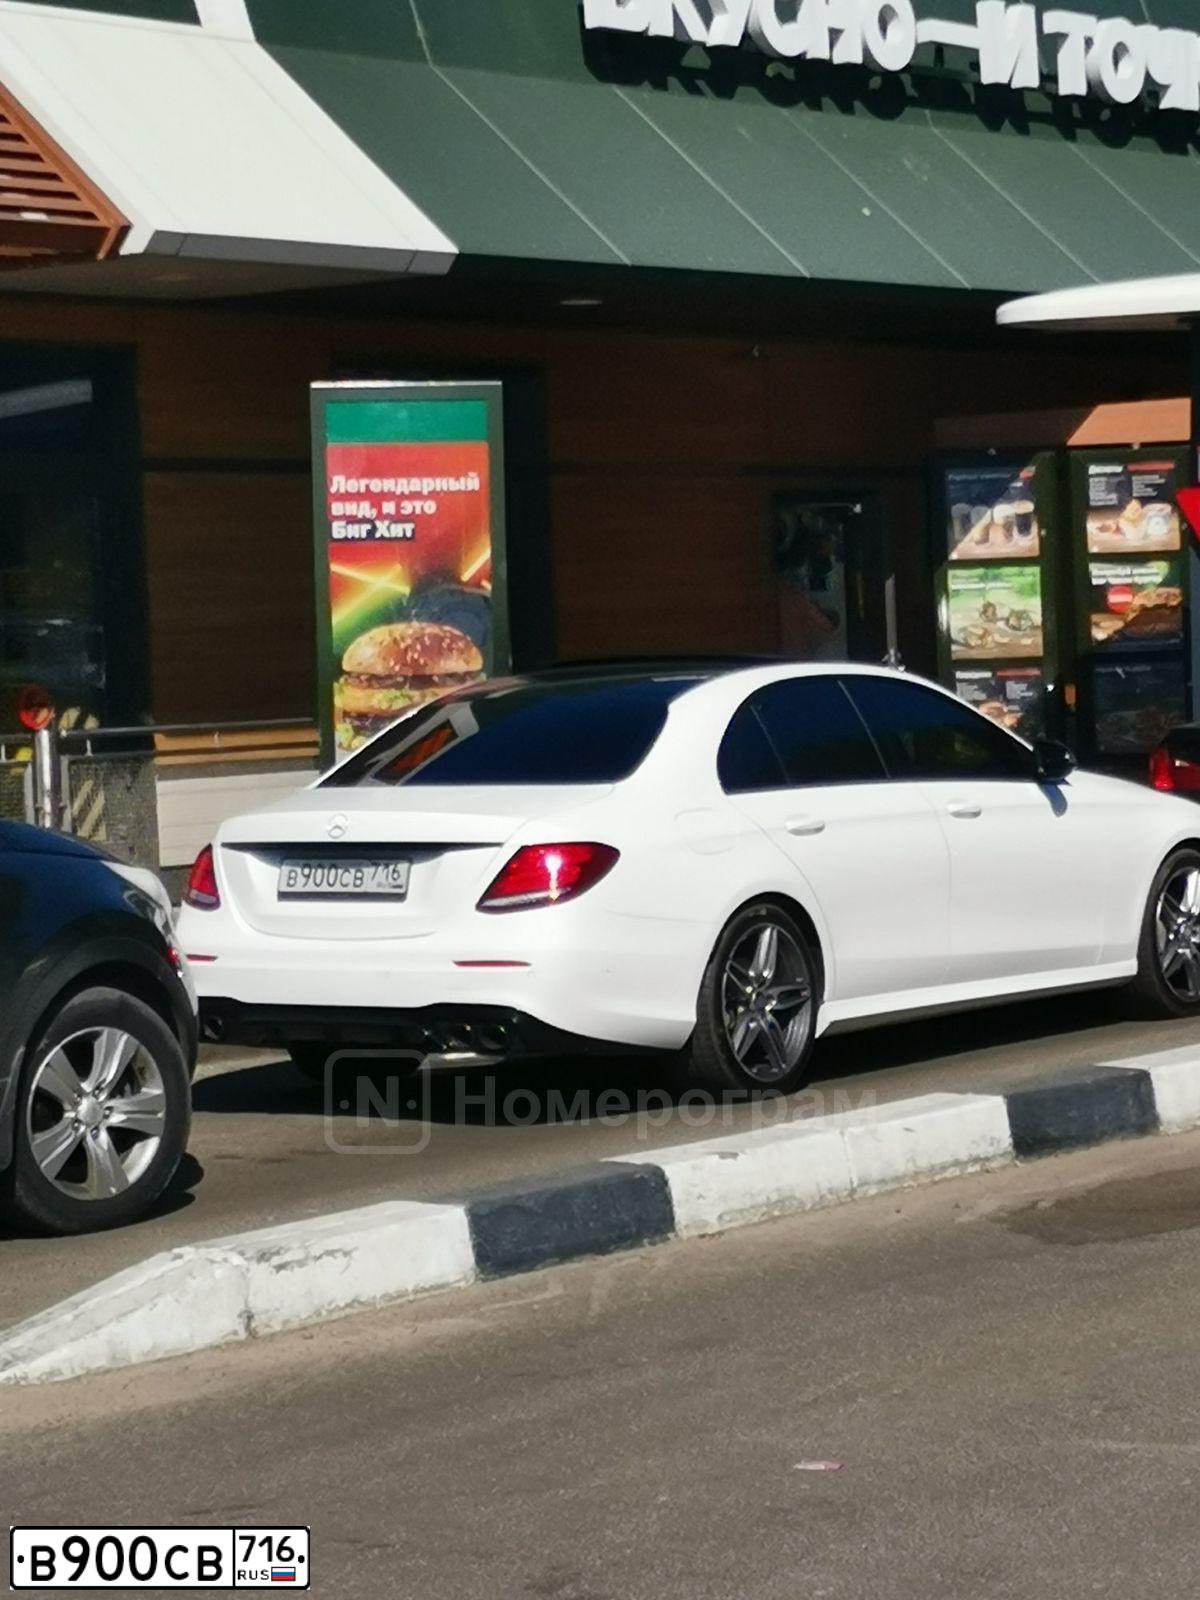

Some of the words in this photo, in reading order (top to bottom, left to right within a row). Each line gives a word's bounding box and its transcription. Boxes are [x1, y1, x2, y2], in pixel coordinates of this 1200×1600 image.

[330, 472, 480, 495] Легендарный
[400, 500, 437, 515] это
[331, 521, 371, 539] Биг
[374, 521, 415, 539] Хит
